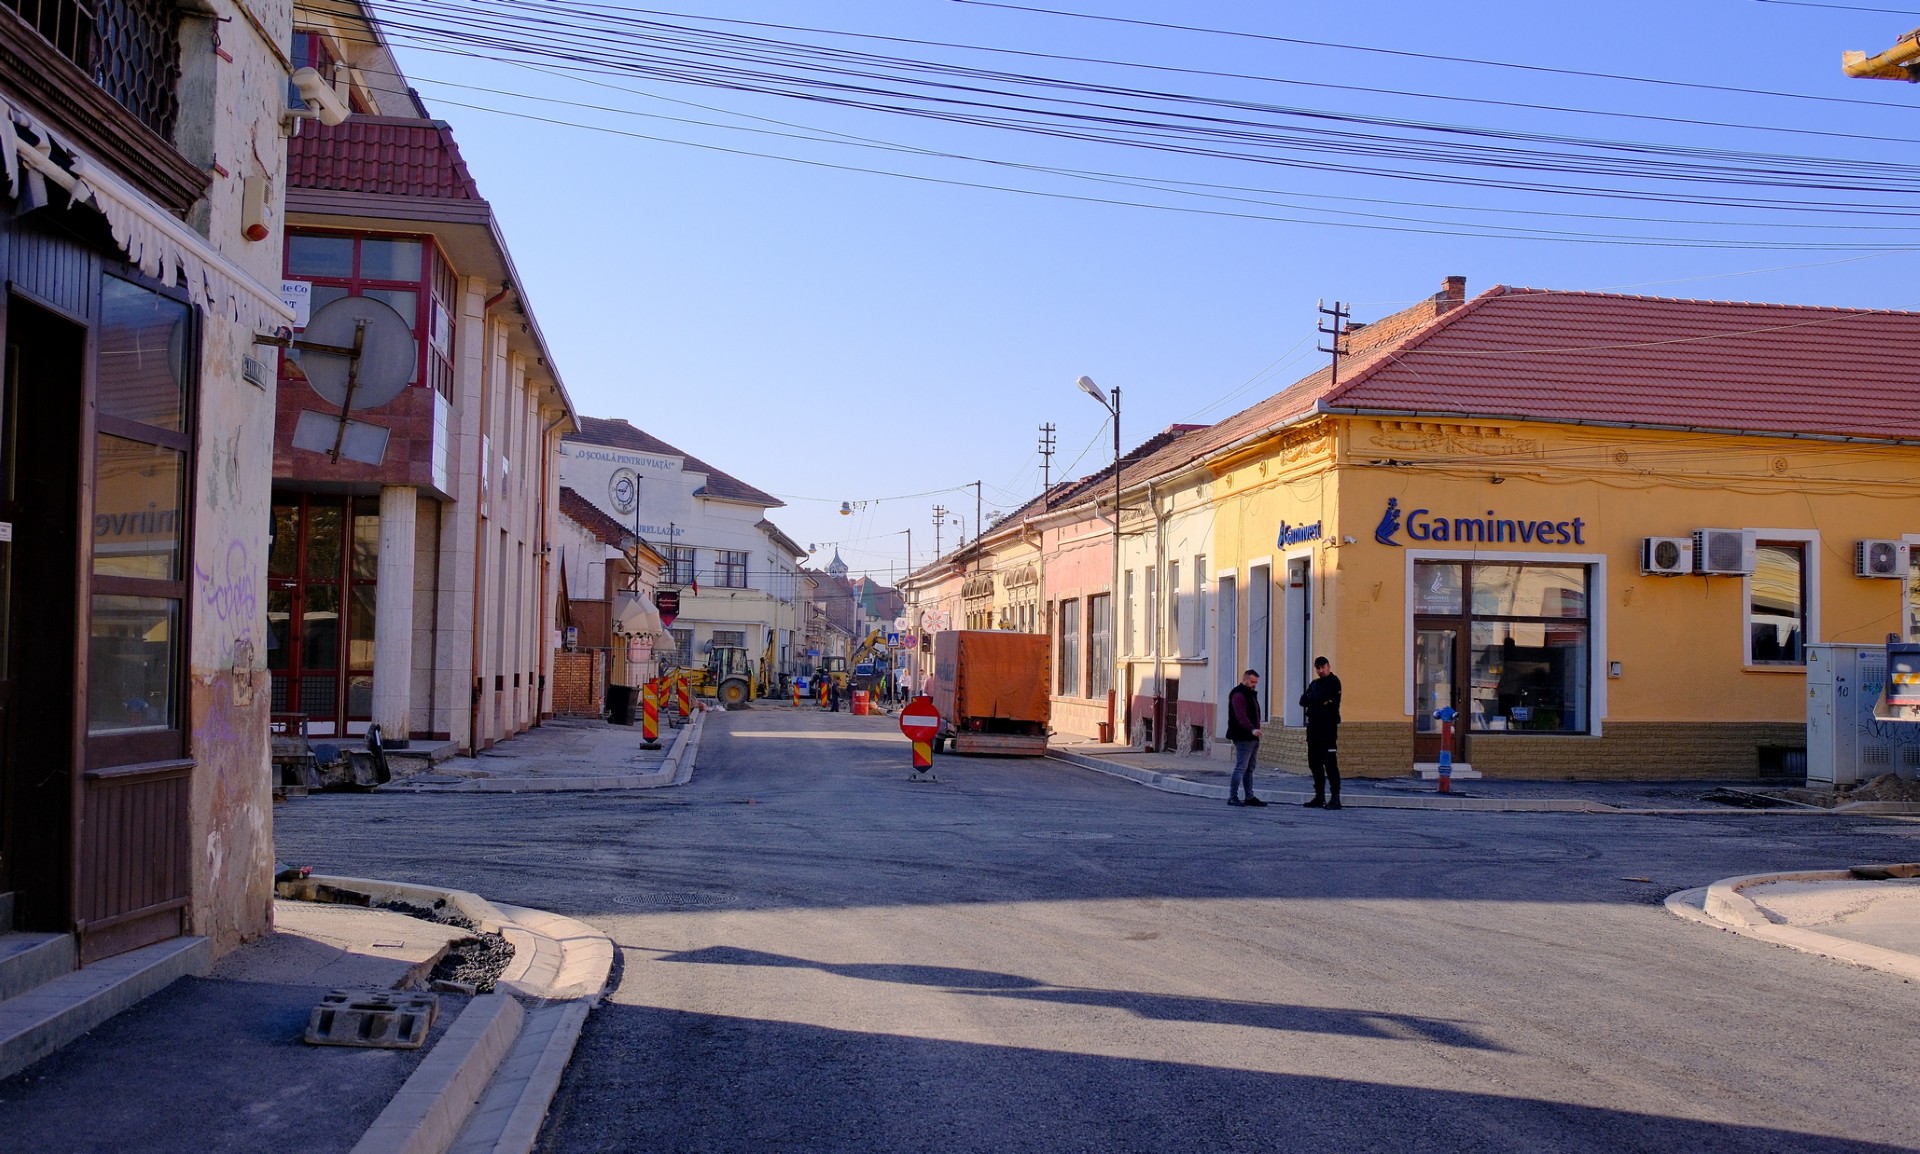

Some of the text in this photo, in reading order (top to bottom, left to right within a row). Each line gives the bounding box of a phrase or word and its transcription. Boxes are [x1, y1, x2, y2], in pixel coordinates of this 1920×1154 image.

[294, 284, 308, 293] Co
[617, 454, 645, 466] PENTRU
[1284, 520, 1322, 545] Gaminvest
[1406, 508, 1585, 545] Gaminvest
[1837, 685, 1849, 697] 10
